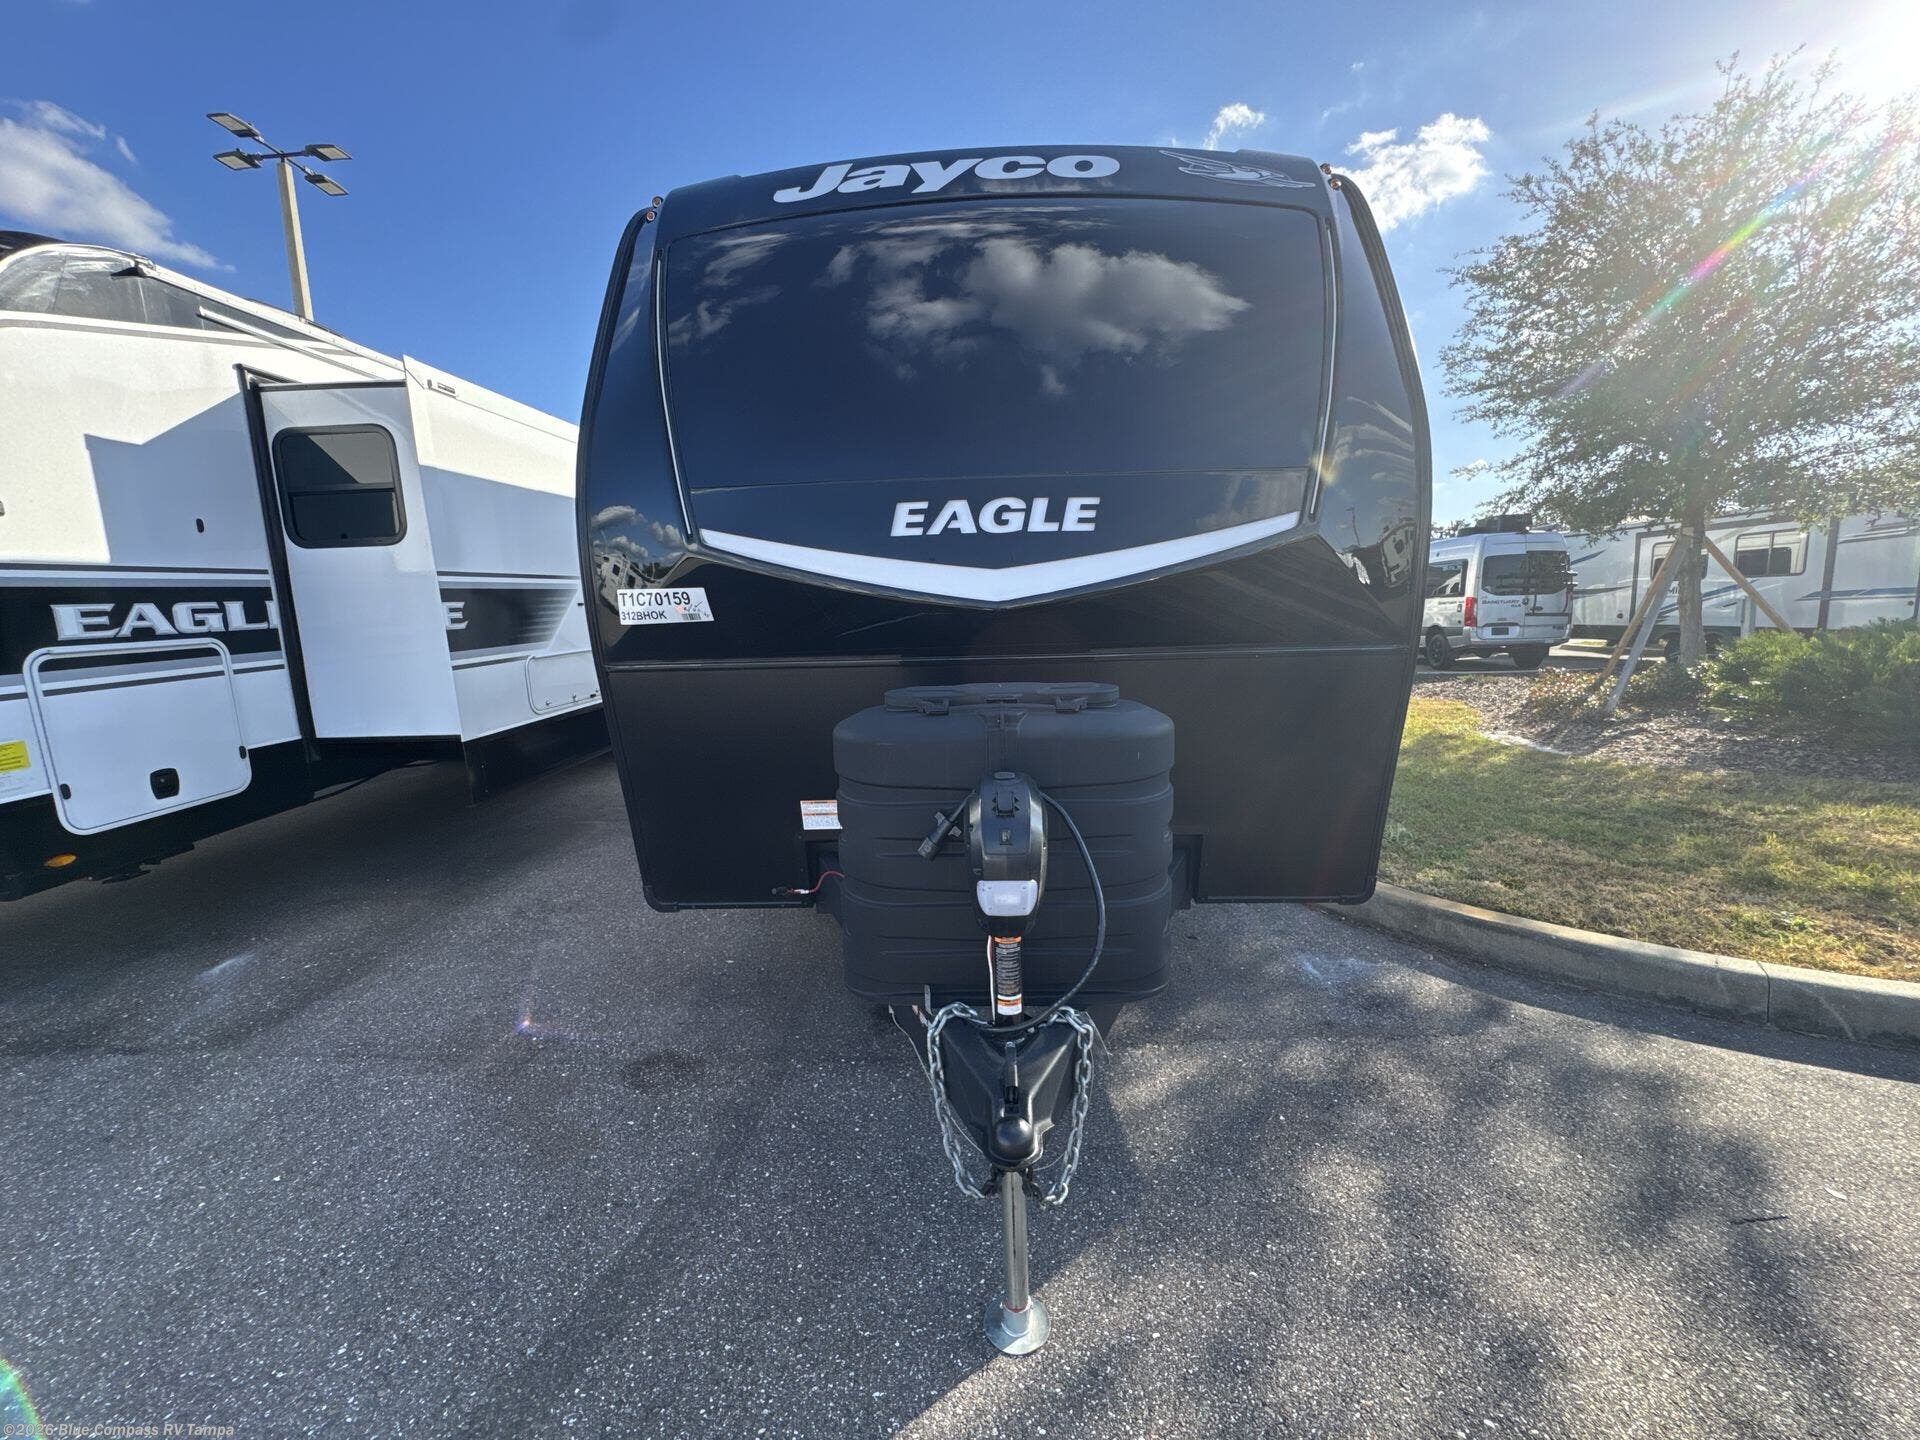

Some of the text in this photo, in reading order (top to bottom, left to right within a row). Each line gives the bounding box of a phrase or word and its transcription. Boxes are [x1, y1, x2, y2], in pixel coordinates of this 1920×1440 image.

[773, 155, 1120, 204] Jayco
[890, 496, 1101, 537] EAGLE
[619, 591, 691, 607] T1C70159
[621, 610, 667, 621] 312BHOK
[50, 600, 278, 641] EAGL
